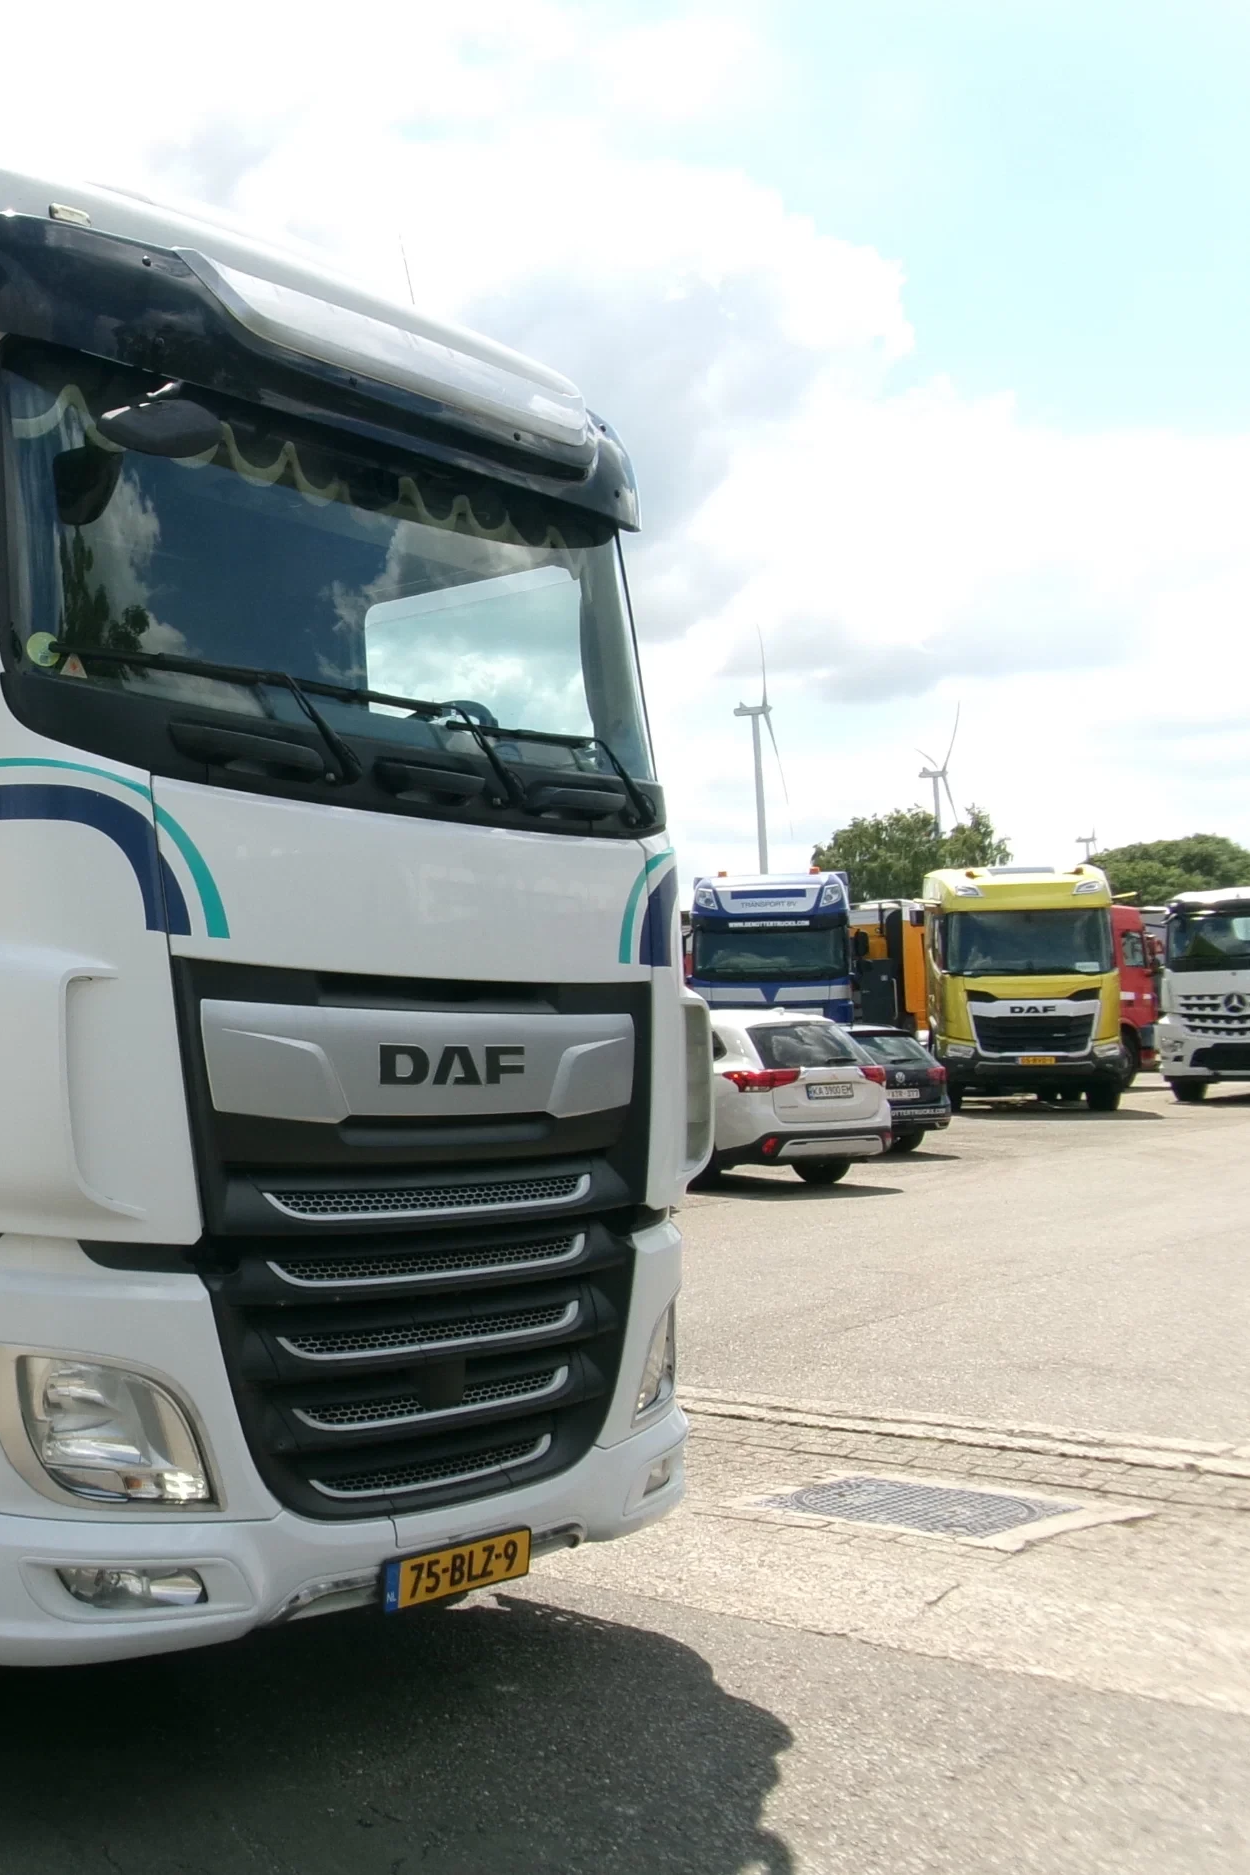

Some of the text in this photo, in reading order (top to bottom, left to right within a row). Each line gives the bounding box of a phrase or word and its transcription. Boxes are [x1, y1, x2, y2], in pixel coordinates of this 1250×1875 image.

[741, 900, 785, 909] TRANSPORT
[1010, 1005, 1056, 1014] DAF
[379, 1043, 525, 1085] DAF
[812, 1085, 824, 1096] KA
[410, 1539, 518, 1599] 75-BLZ-9
